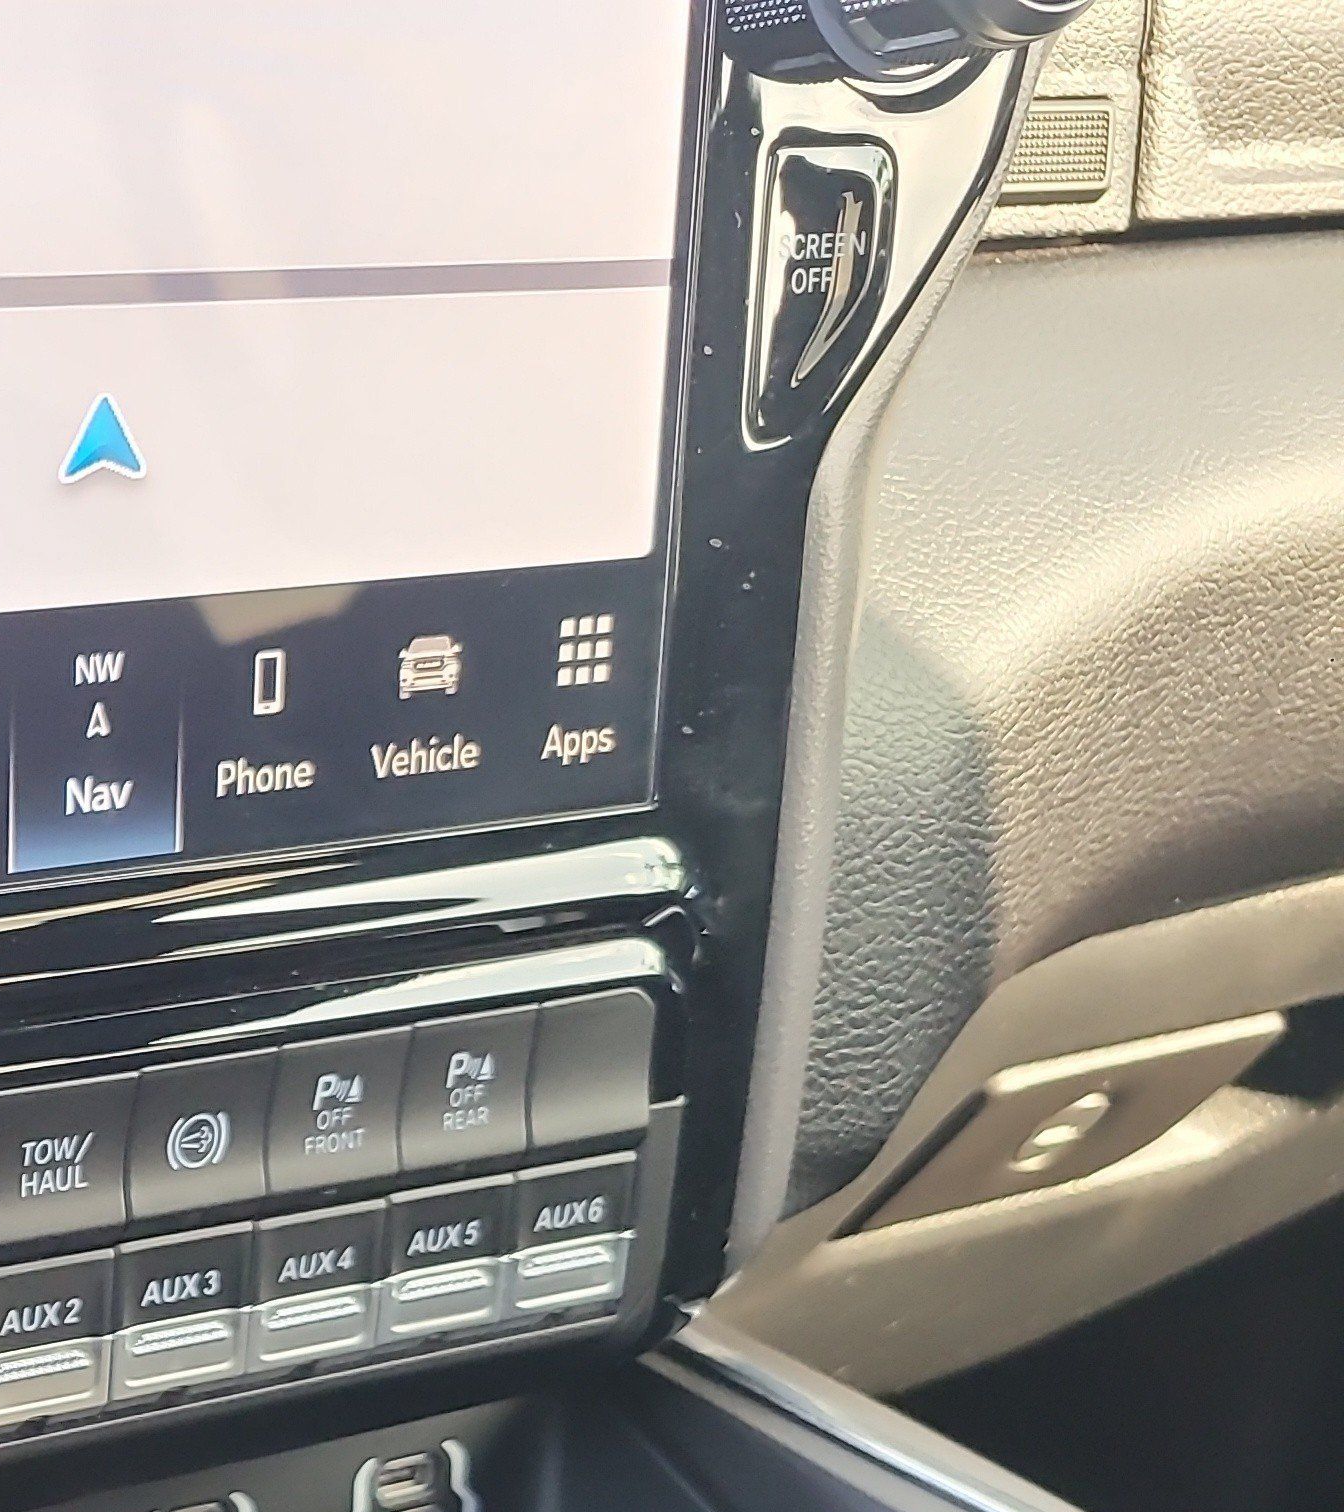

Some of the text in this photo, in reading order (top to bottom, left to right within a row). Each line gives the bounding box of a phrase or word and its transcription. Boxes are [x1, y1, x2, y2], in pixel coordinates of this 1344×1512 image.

[778, 230, 867, 260] SCREEN
[791, 266, 834, 295] OFF
[74, 650, 126, 686] NW
[369, 732, 482, 779] Vehicle
[539, 724, 616, 764] Apps
[215, 756, 316, 799] Phone
[64, 776, 136, 816] Nav
[449, 1083, 488, 1108] OFF
[315, 1106, 354, 1131] OFF
[442, 1106, 490, 1132] REAR
[21, 1131, 97, 1168] TOW/
[304, 1128, 366, 1156] FRONT
[20, 1164, 90, 1198] HAUL
[533, 1200, 588, 1233] AUX
[406, 1218, 484, 1257] AUX 5
[278, 1245, 357, 1284] AUX 4
[140, 1268, 223, 1308] AUX 3
[62, 1297, 84, 1325] 2
